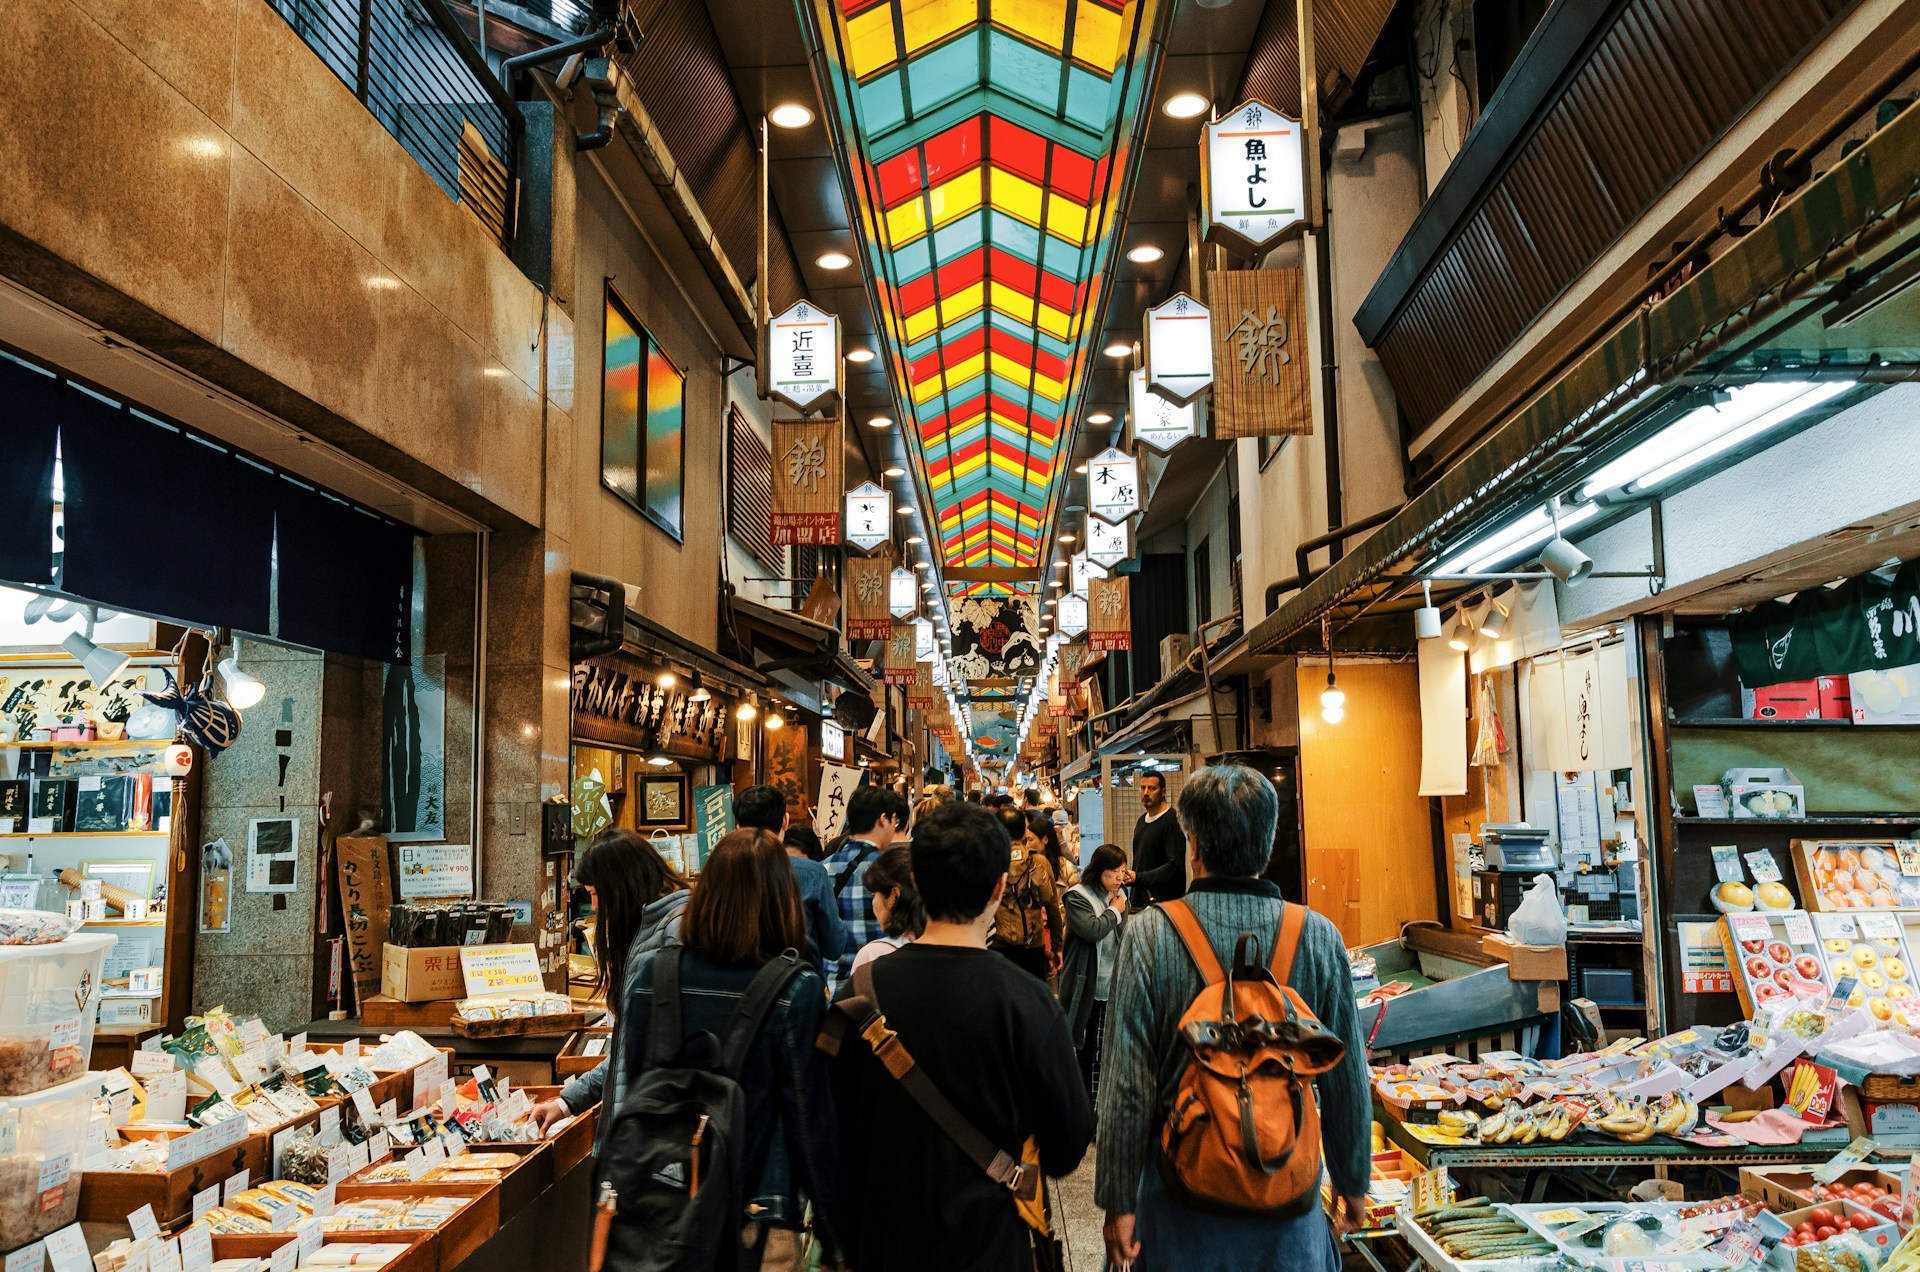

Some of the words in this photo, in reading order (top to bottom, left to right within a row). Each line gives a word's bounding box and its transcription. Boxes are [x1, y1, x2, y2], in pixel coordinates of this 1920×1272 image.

[1245, 138, 1267, 208] 魚よし
[792, 330, 814, 377] 近喜
[1224, 304, 1290, 386] 錦
[781, 436, 826, 494] 錦
[773, 525, 836, 545] 加盟店
[854, 568, 882, 607] 錦
[1095, 584, 1122, 620] 錦
[848, 628, 889, 640] 加盟店
[1810, 1095, 1827, 1111] Dole
